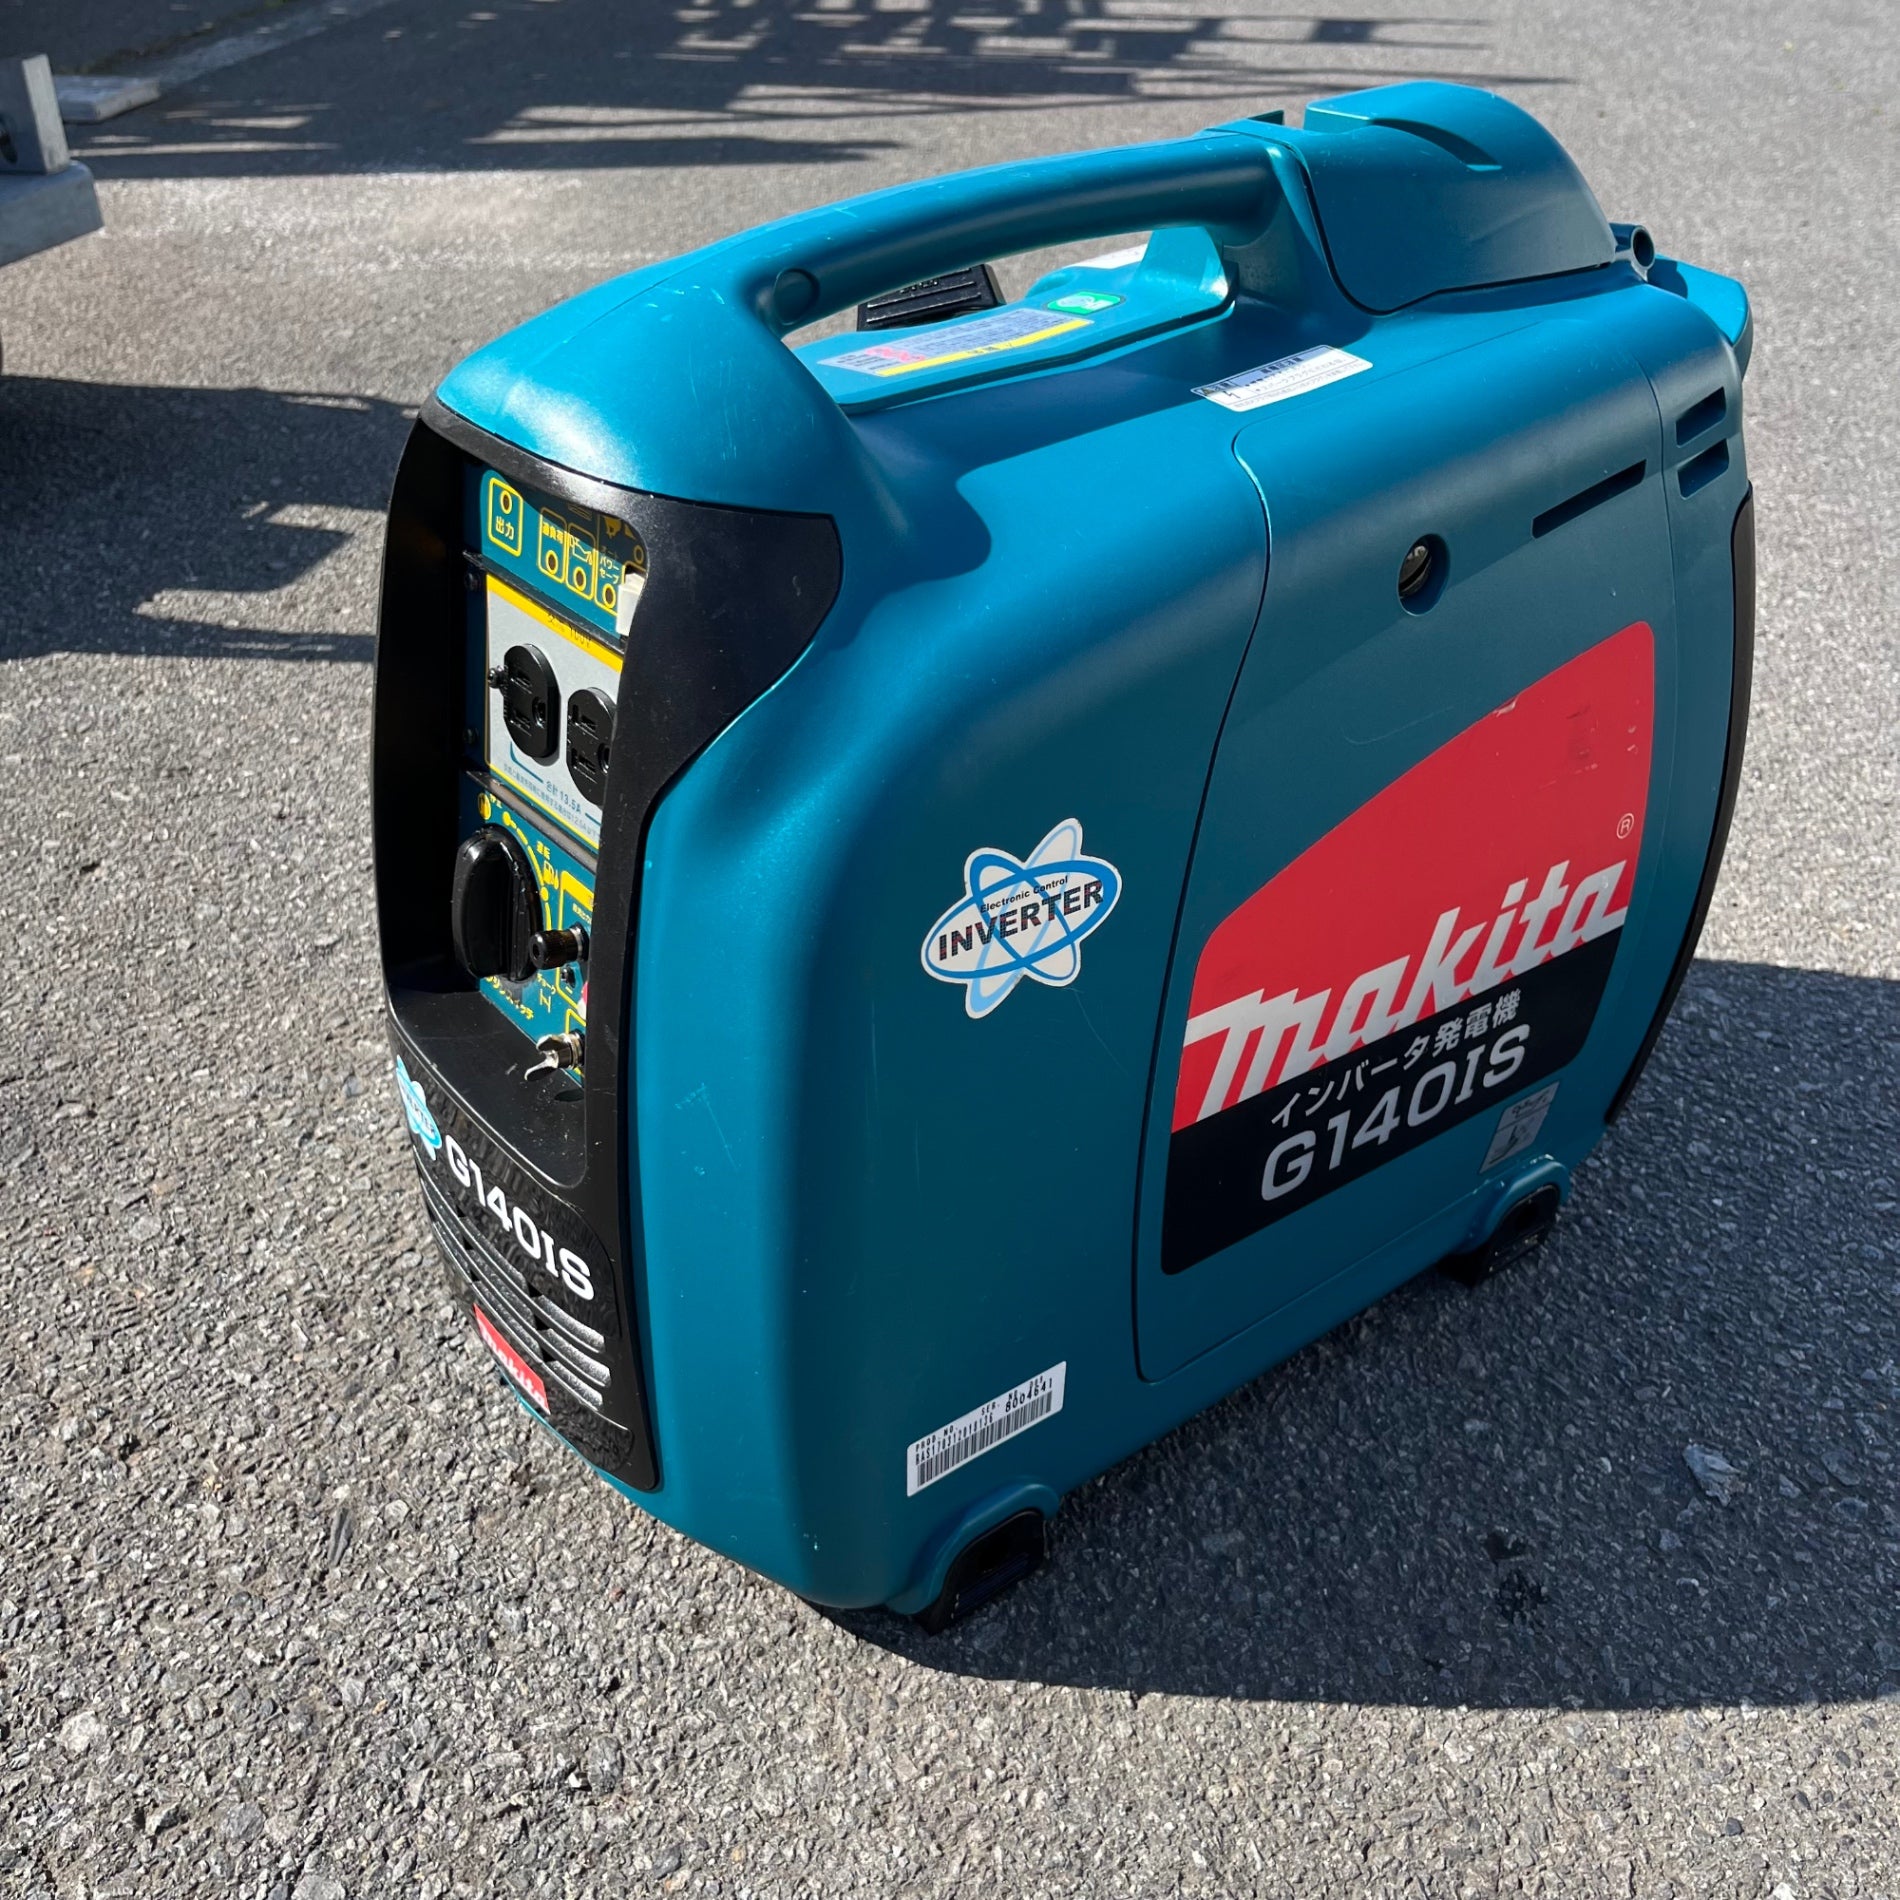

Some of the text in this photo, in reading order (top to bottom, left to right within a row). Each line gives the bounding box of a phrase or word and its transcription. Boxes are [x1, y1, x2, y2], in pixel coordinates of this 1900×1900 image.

[496, 515, 514, 540] 出力
[938, 880, 1104, 961] INVERTER
[980, 875, 1068, 914] Electronic Control
[1184, 860, 1628, 1122] makita
[1271, 989, 1521, 1129] インバータ発電機
[1261, 1023, 1530, 1201] G140IS
[445, 1134, 594, 1300] G140IS
